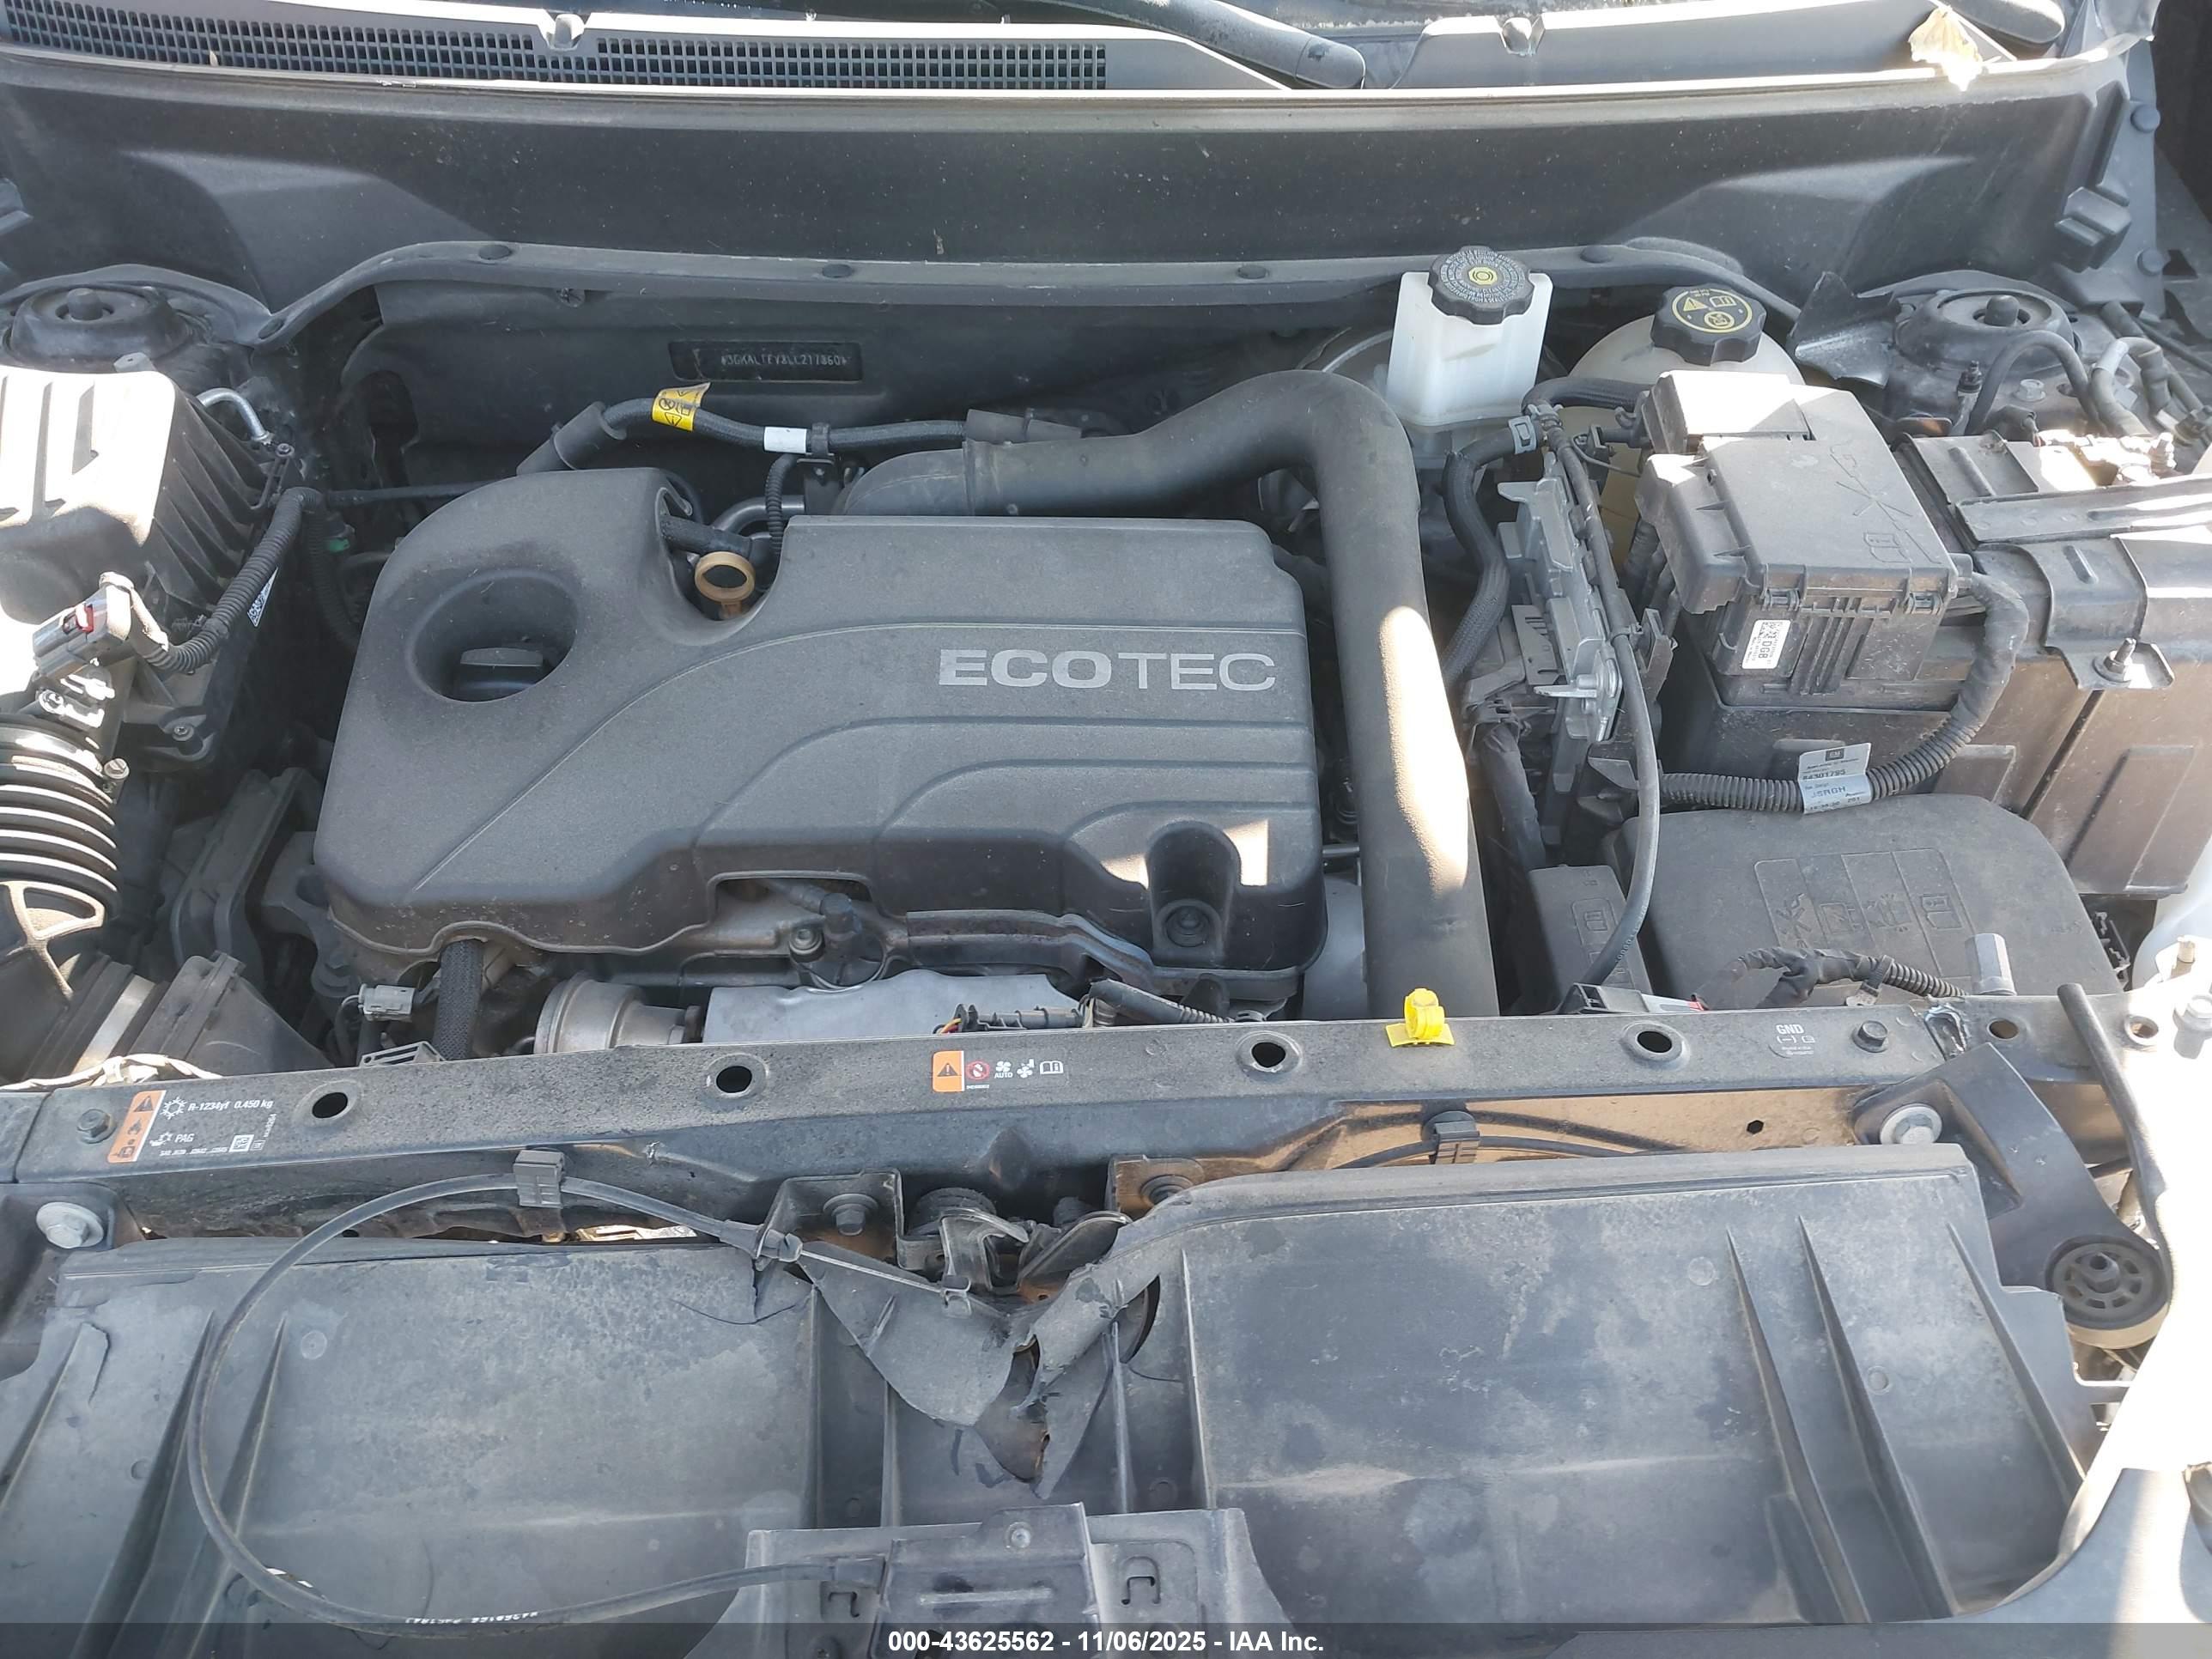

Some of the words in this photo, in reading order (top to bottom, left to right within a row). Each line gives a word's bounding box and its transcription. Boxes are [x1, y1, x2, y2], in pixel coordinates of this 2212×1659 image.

[939, 648, 1277, 691] ECOTEC
[1776, 1024, 1804, 1034] GND
[187, 1101, 231, 1112] R-1234yf
[234, 1100, 259, 1109] 0.450
[260, 1099, 274, 1109] kg
[174, 1133, 195, 1143] PAG
